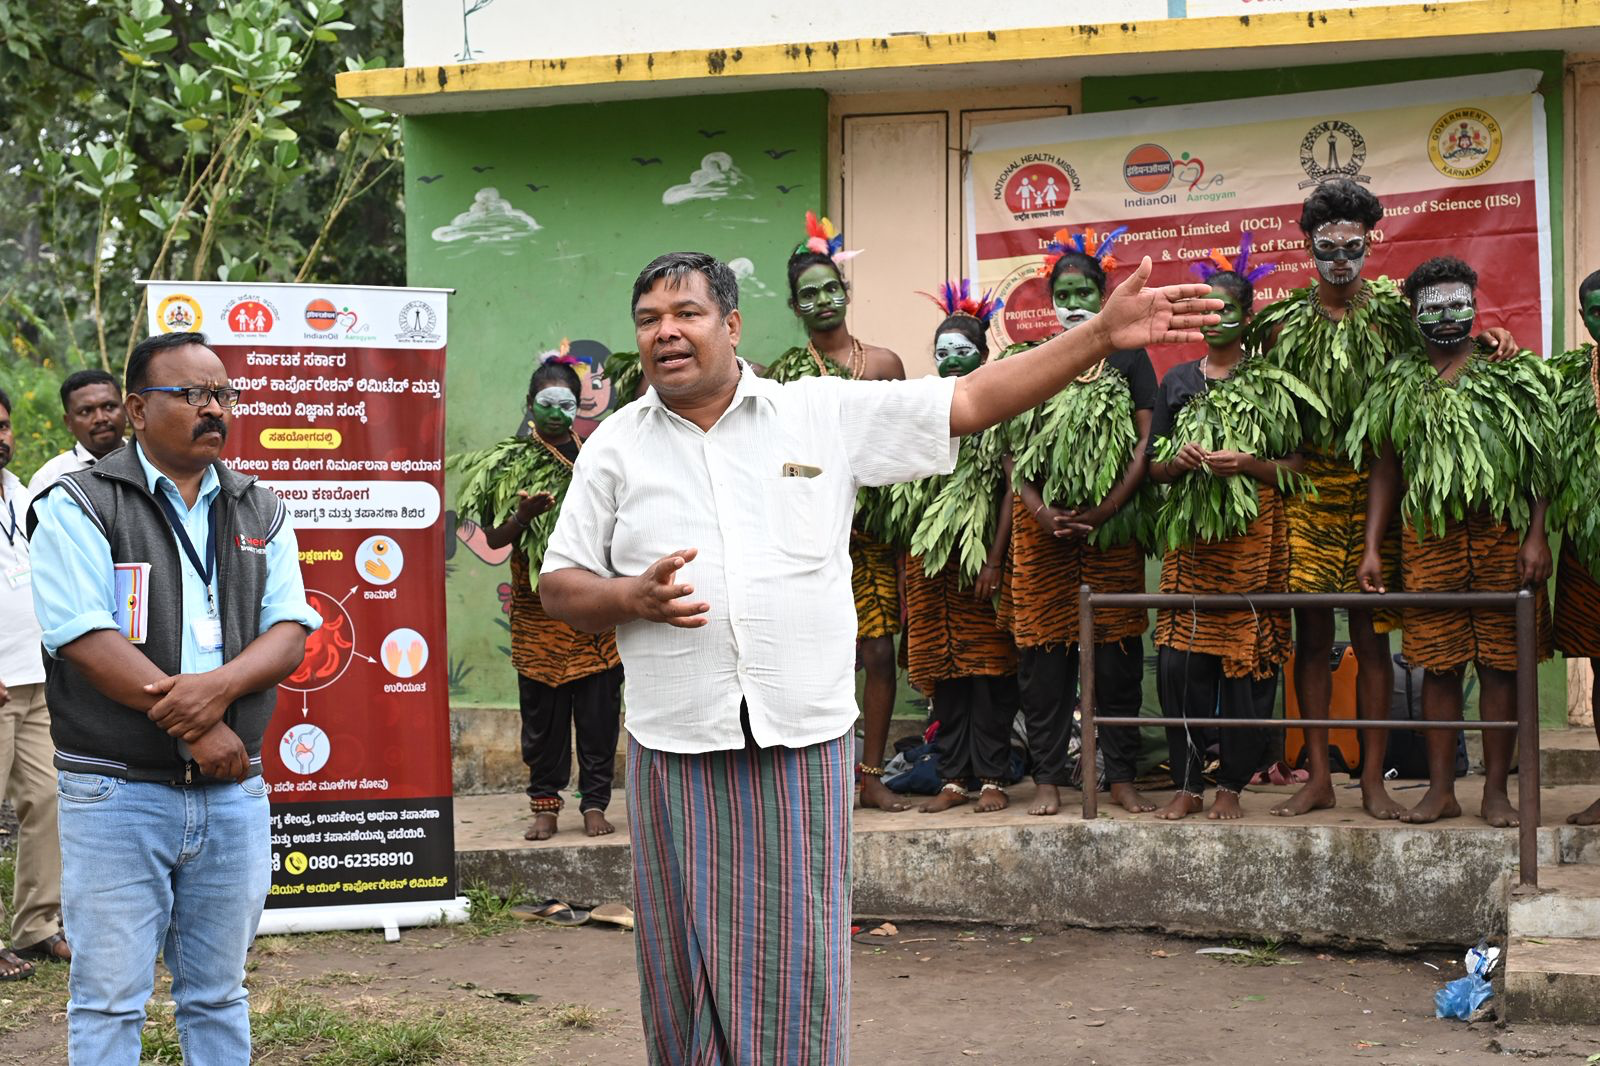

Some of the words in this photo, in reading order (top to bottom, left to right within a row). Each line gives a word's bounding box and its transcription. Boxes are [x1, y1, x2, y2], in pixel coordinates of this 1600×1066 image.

[1432, 110, 1487, 141] GOVERNMENT
[1487, 122, 1497, 134] OF
[994, 160, 1022, 200] NATIONAL
[1020, 153, 1055, 165] HEALTH
[1055, 157, 1081, 192] MISSION
[1441, 159, 1492, 177] KARNATAKA
[1124, 194, 1177, 208] IndianOil
[1186, 191, 1237, 203] Aarogyam
[1180, 220, 1230, 238] Limited
[1240, 216, 1282, 233] (IOCL)
[1382, 205, 1410, 218] tute
[1413, 200, 1427, 213] of
[1429, 198, 1482, 212] Science
[1485, 192, 1521, 211] (IISc)
[1161, 249, 1172, 261] &
[1260, 240, 1274, 253] of
[1005, 310, 1036, 321] PROJECT
[246, 352, 302, 368] ಕರ್ನಾಟಕ
[303, 352, 347, 368] ಸರ್ಕಾರ
[356, 377, 410, 394] ಲಿಮಿಟೆಡ್
[411, 379, 442, 399] ಮತ್ತು
[230, 401, 292, 420] ಭಾರತೀಯ
[294, 401, 335, 423] ವಿಜ್ಞಾನ
[336, 400, 369, 425] ಸಂಸ್ಥೆ
[268, 431, 335, 446] ಸಹಯೋಗದಲ್ಲಿ
[271, 457, 291, 471] ಕಣ
[292, 456, 324, 472] ರೋಗ
[325, 457, 389, 472] ನಿರ್ಮೂಲನಾ
[390, 458, 442, 474] ಅಭಿಯಾನ
[311, 486, 370, 502] ಕಣರೋಗ
[293, 507, 326, 523] ಜಾಗೃತಿ
[328, 507, 353, 523] ಮತ್ತು
[354, 506, 399, 520] ತಪಾಸಣಾ
[400, 506, 426, 520] ಶಿಬಿರ
[363, 587, 397, 601] ಕಾಮಾಲೆ
[273, 780, 295, 793] ಪದೇ
[296, 779, 318, 792] ಪದೇ
[318, 778, 358, 791] ಮೂಳೆಗಳ
[359, 777, 389, 791] ನೋವು
[316, 810, 366, 826] ಉಪಕೇಂದ್ರ
[366, 810, 398, 823] ಅಥವಾ
[399, 807, 440, 821] ತಪಾಸಣಾ
[308, 850, 414, 870] 080-62358910
